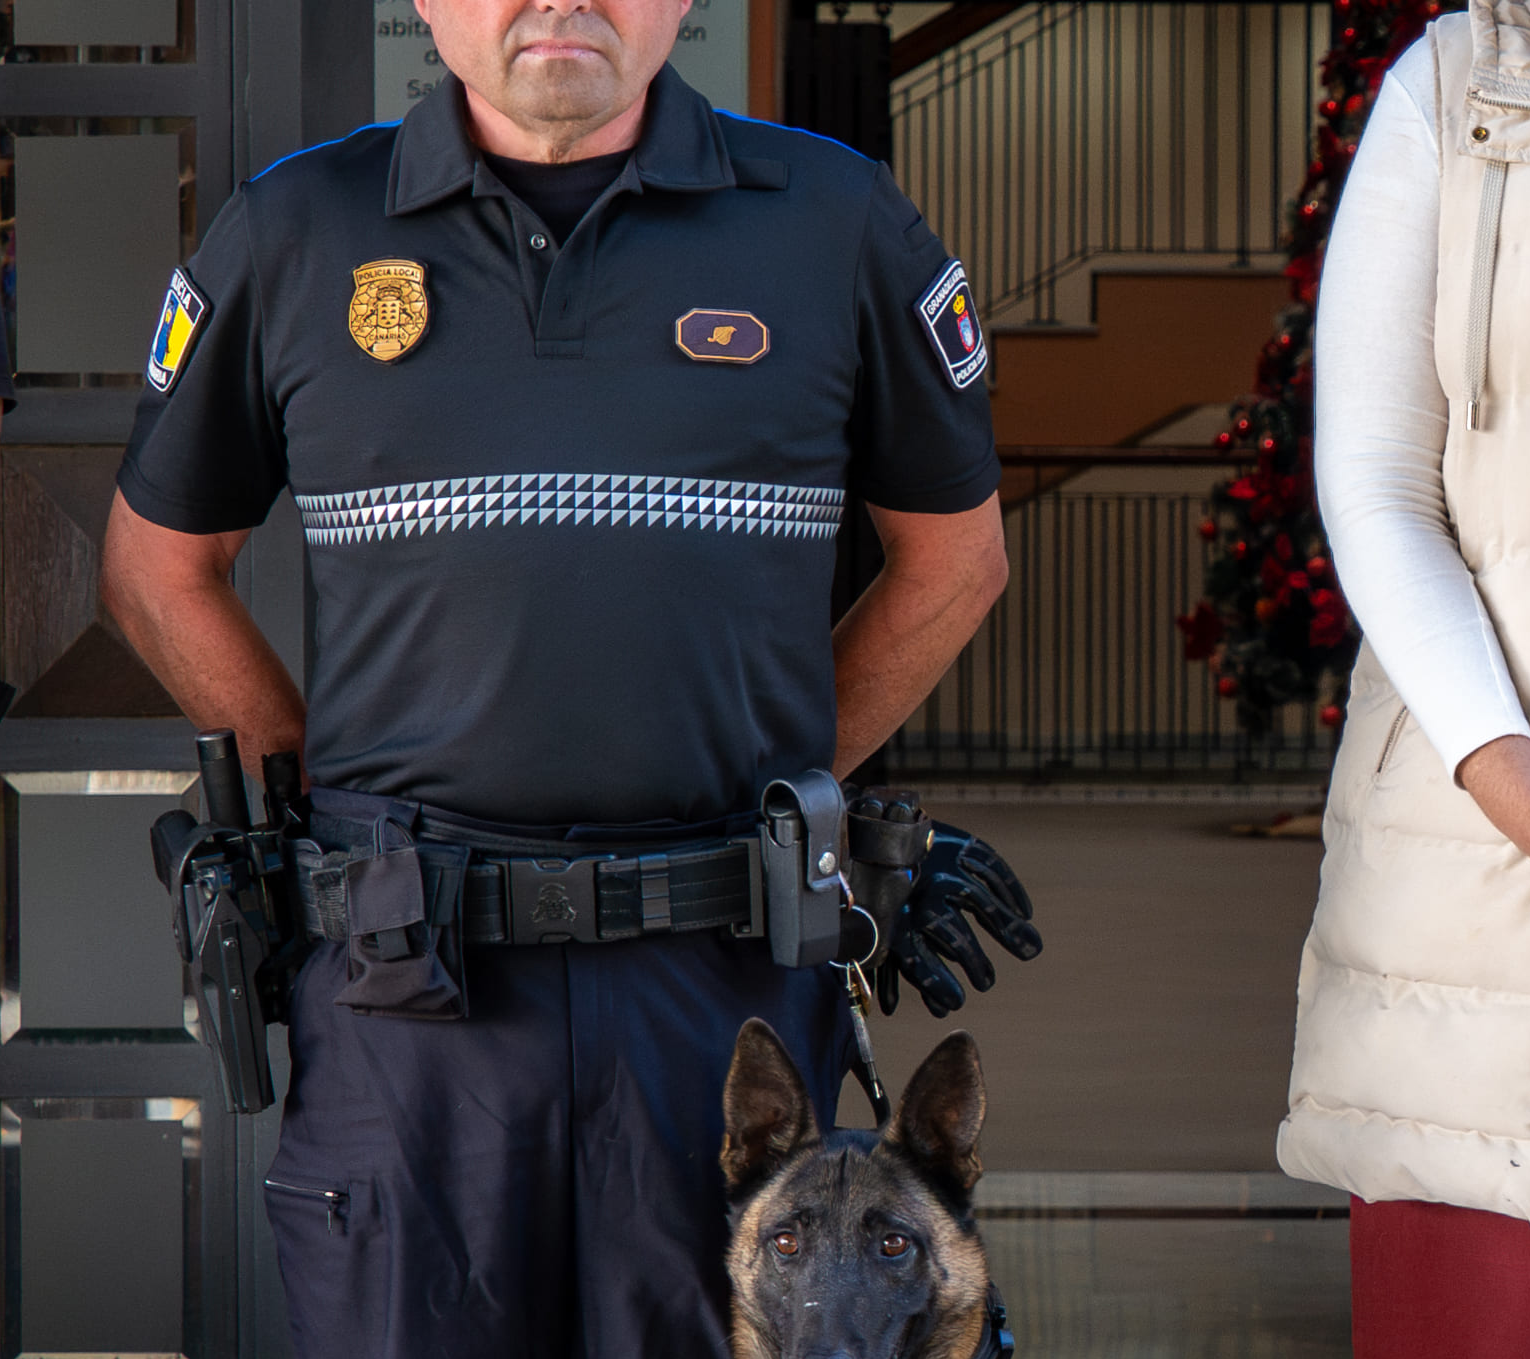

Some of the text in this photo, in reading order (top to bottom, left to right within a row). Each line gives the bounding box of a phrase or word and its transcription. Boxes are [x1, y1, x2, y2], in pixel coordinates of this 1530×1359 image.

[358, 268, 419, 280] POLICIA LOCAL
[368, 333, 406, 342] CANARIAS
